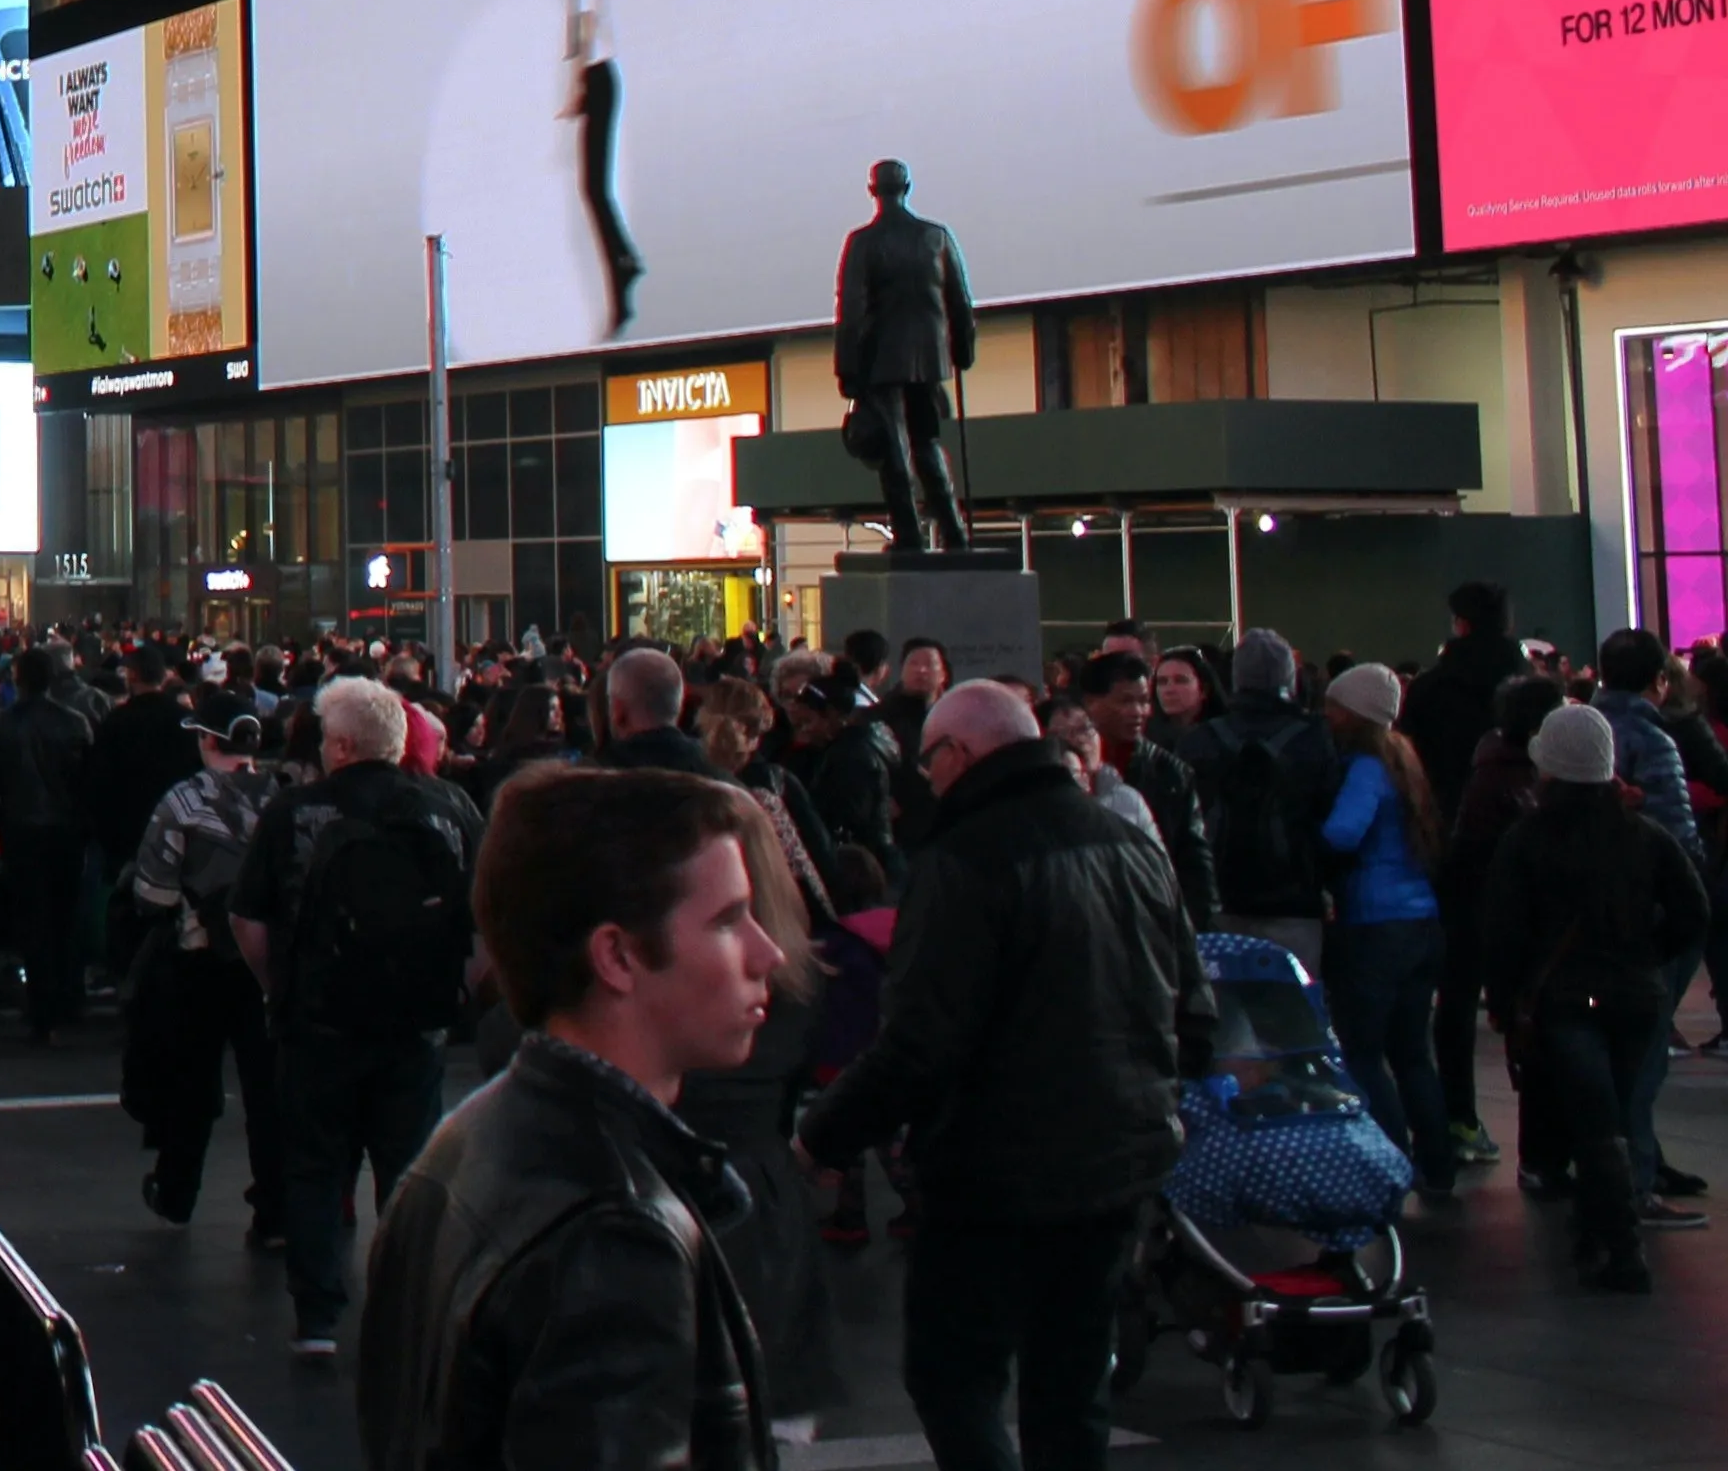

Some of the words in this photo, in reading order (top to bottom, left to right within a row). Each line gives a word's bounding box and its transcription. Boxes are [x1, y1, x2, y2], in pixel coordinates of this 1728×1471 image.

[1561, 10, 1613, 45] FOR
[1619, 3, 1646, 35] 12
[66, 61, 108, 94] ALWAYS
[67, 91, 100, 117] WANT
[73, 109, 99, 137] more
[63, 133, 106, 179] freedom
[50, 177, 112, 217] swatch
[1509, 193, 1540, 212] Service
[1583, 185, 1616, 202] Unused
[1617, 184, 1637, 198] data
[1638, 182, 1657, 196] rolls
[1657, 176, 1693, 192] forward
[1694, 174, 1716, 188] after
[637, 370, 730, 417] INVICTA
[55, 553, 90, 579] 1515
